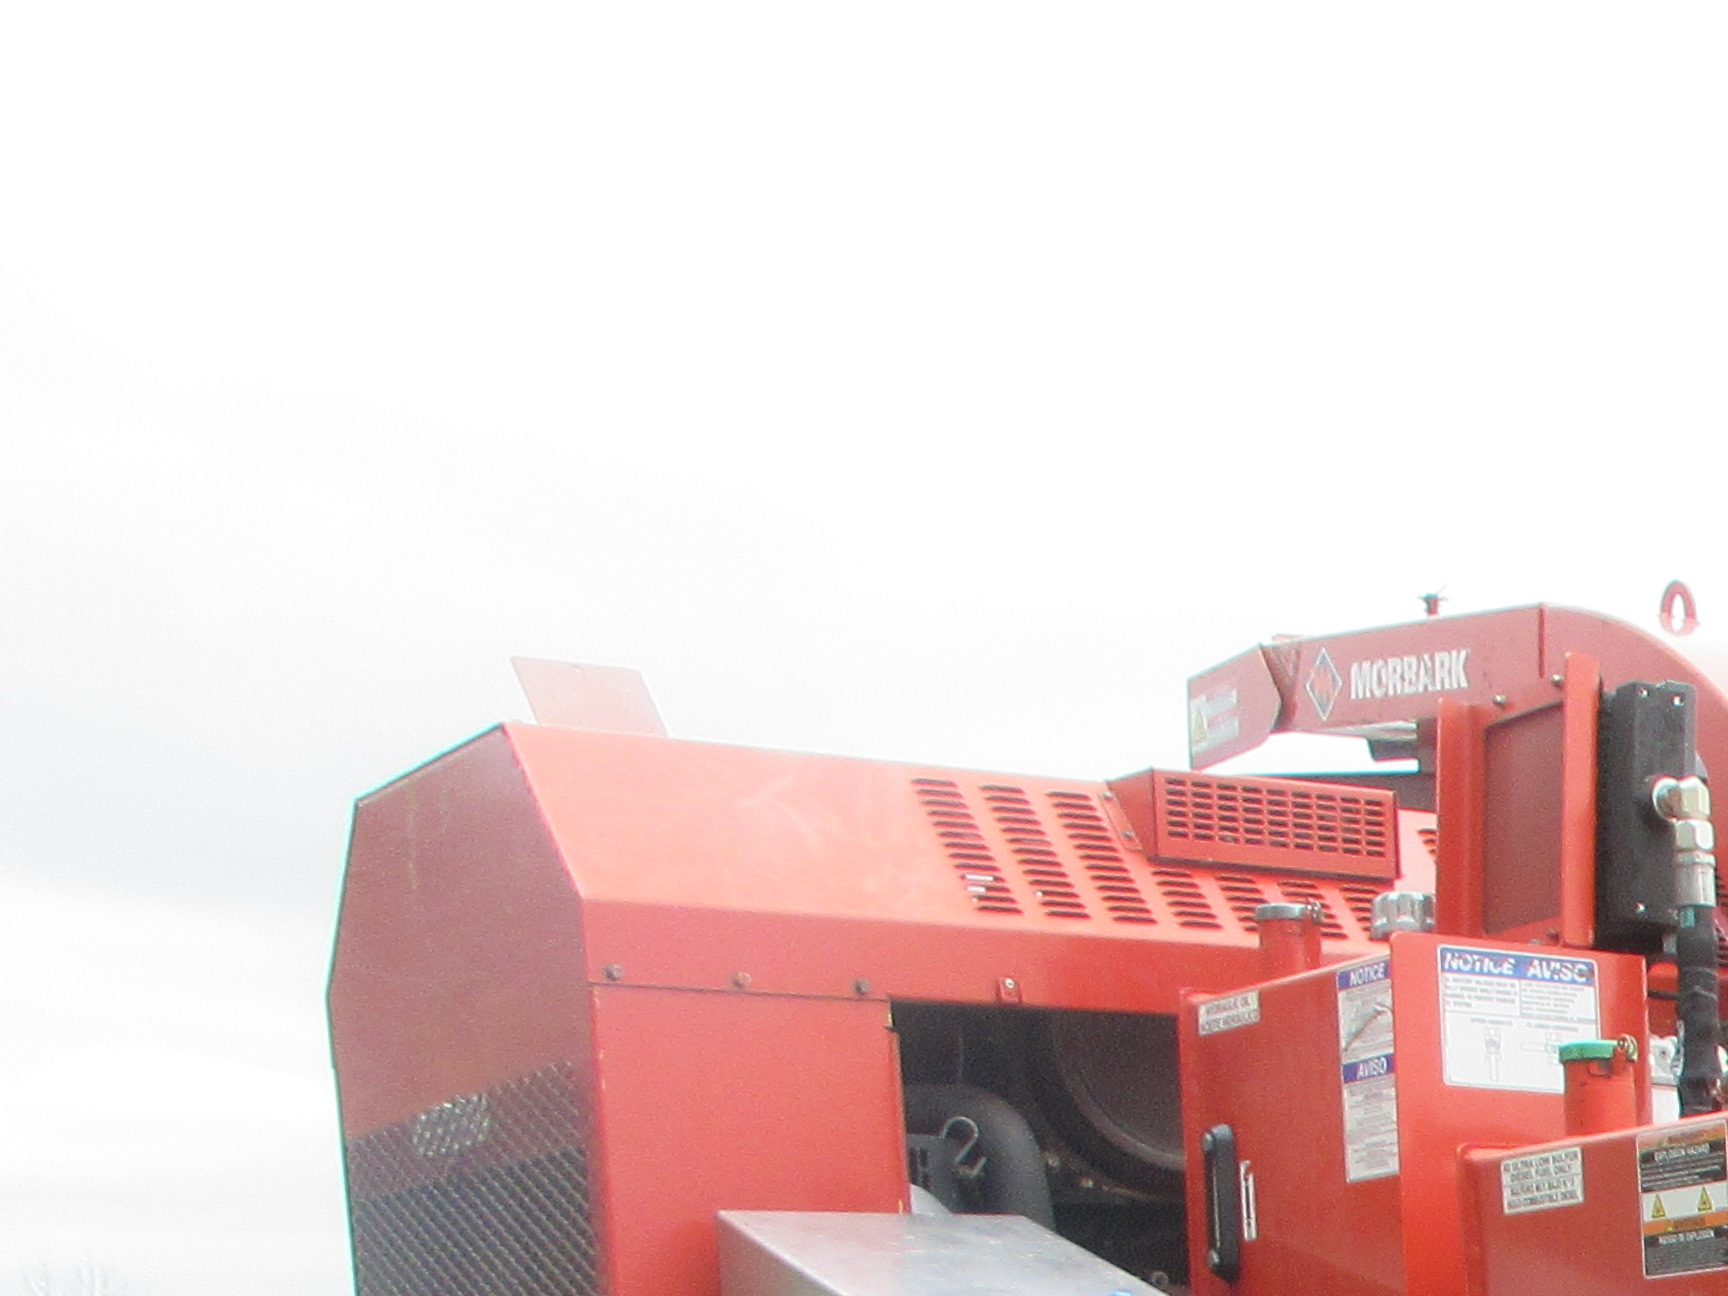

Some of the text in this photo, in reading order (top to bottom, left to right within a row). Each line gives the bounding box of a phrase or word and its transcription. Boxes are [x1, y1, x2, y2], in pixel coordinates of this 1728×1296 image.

[1350, 649, 1470, 700] MORBARK
[1349, 962, 1386, 987] NOTICE
[1444, 952, 1590, 983] NOTICE AVISO
[1356, 1057, 1387, 1080] AVISO
